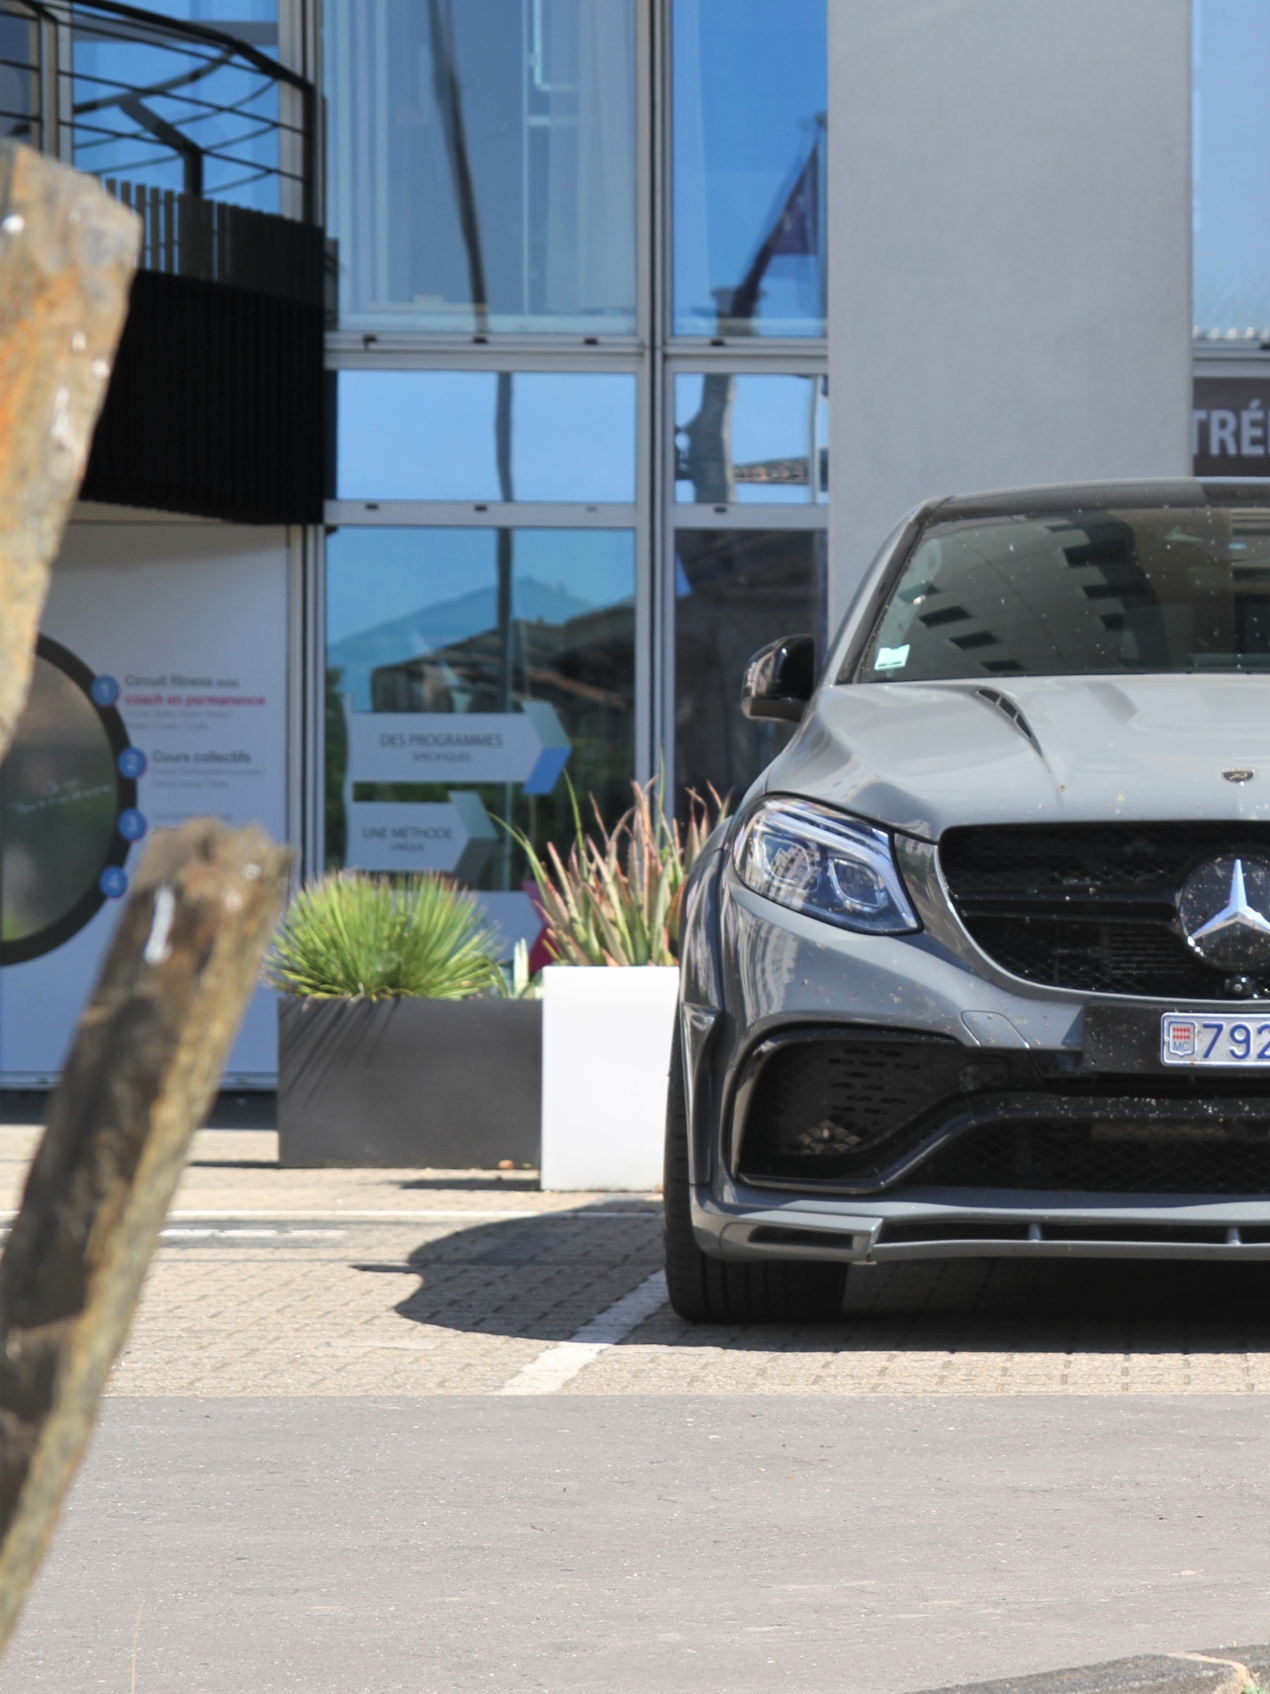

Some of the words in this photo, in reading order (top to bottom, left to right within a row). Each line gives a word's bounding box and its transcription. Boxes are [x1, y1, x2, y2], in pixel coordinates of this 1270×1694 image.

[124, 674, 168, 687] Circuit
[171, 674, 213, 687] fitness
[124, 693, 164, 706] coach
[186, 695, 266, 708] permanence
[380, 733, 406, 746] DES
[409, 733, 502, 746] PROGRAMMES
[152, 750, 190, 764] Cours
[193, 749, 251, 764] collectifs
[361, 826, 388, 838] UNE
[107, 875, 119, 889] 4
[1173, 1041, 1190, 1051] MC
